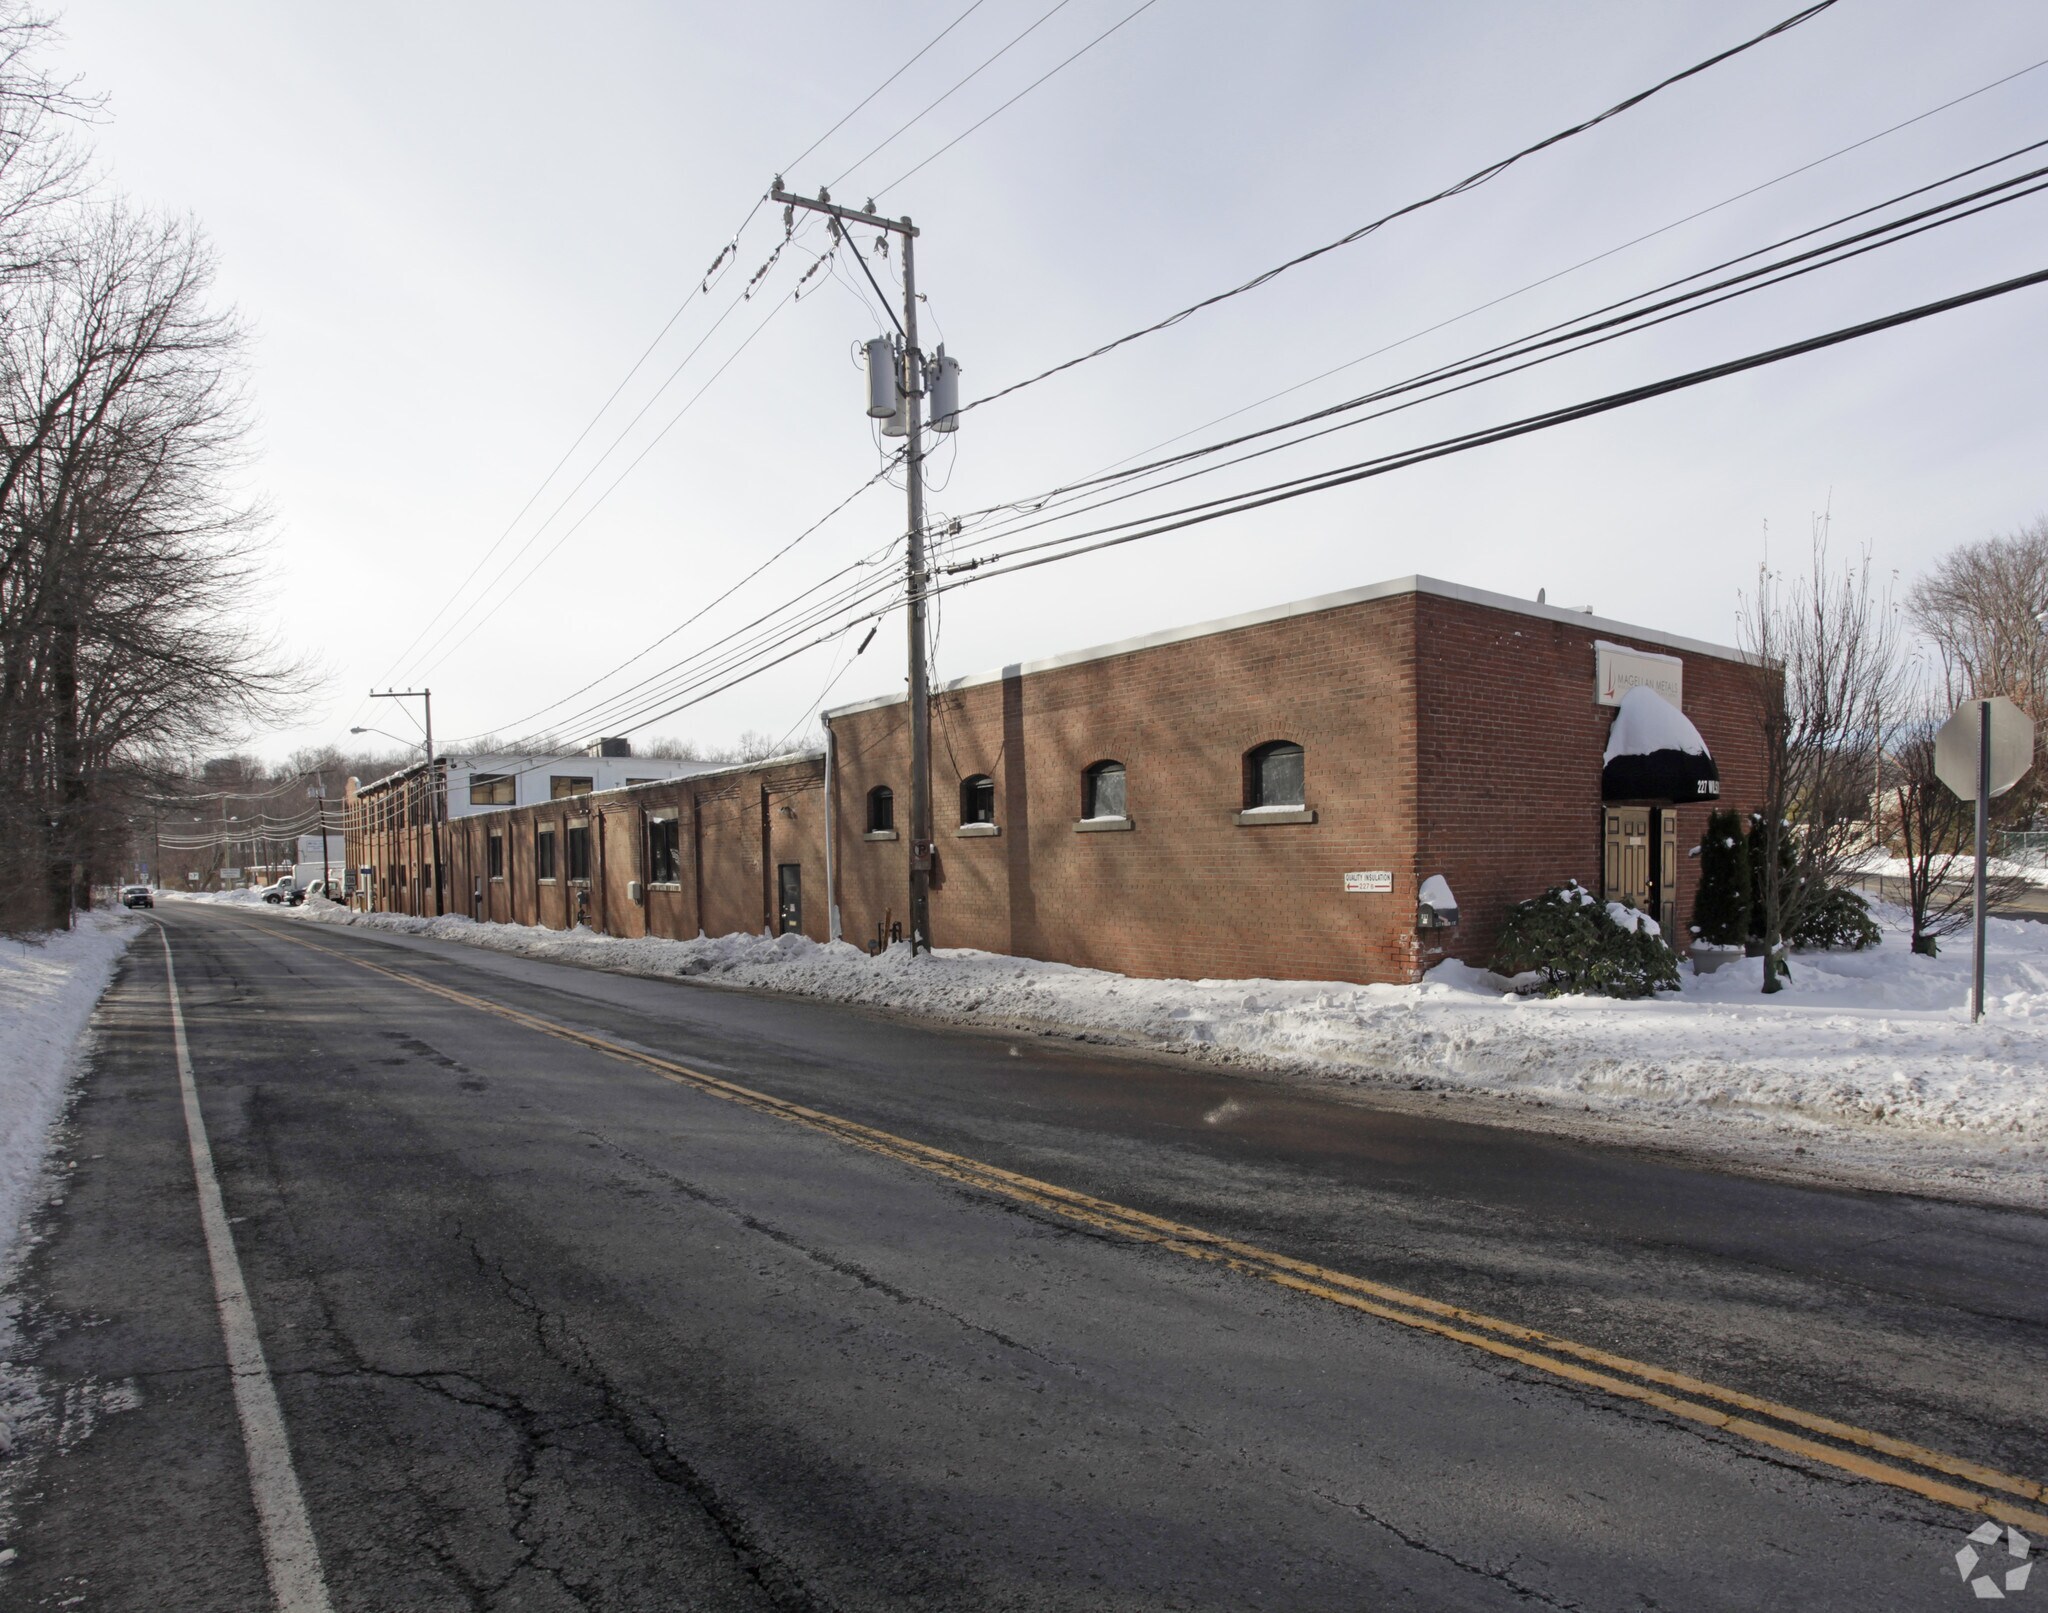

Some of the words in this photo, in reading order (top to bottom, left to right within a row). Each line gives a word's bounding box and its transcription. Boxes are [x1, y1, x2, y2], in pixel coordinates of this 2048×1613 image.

[1617, 674, 1654, 688] MAGELLAN
[1656, 680, 1678, 693] METALS
[1697, 780, 1708, 794] 227
[1346, 873, 1363, 881] QUALITY
[1364, 873, 1391, 881] INSULATION
